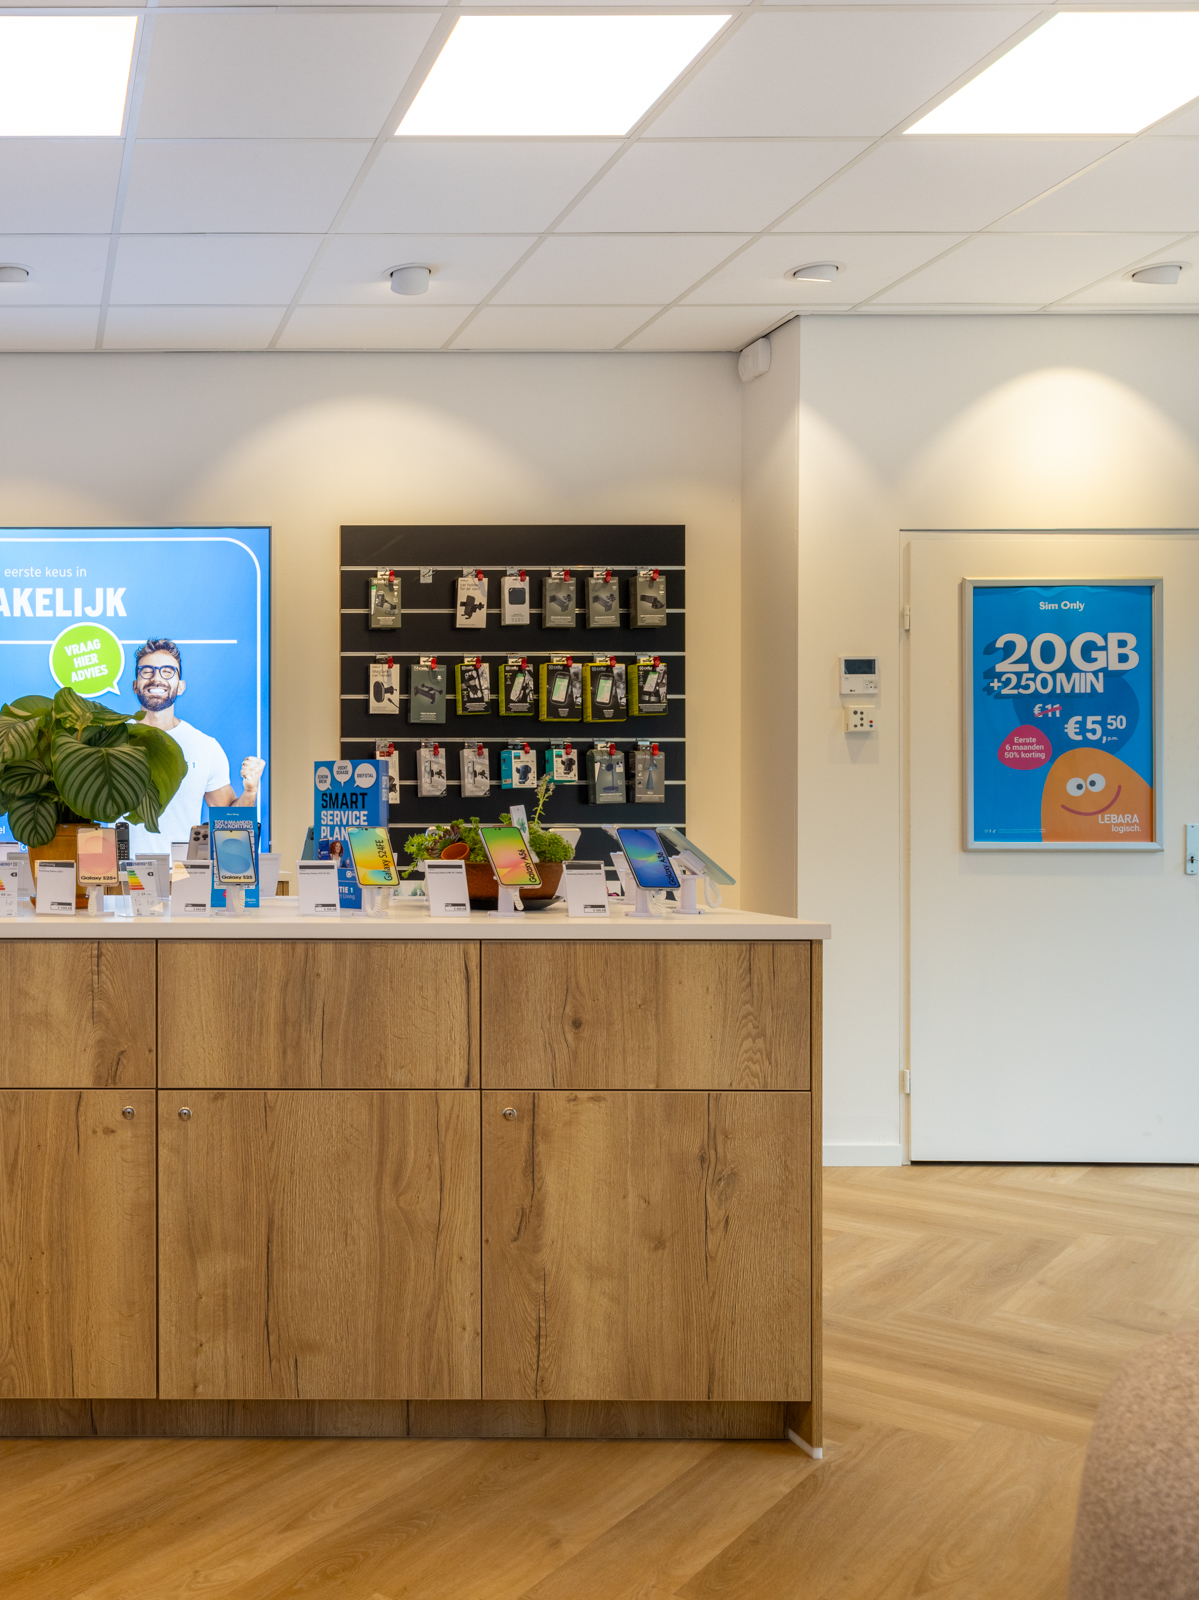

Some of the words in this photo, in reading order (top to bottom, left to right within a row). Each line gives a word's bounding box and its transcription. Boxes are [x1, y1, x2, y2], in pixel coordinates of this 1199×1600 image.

[4, 566, 41, 577] eerste
[45, 566, 73, 577] keus
[76, 566, 87, 577] in
[1039, 601, 1059, 610] Sim
[1060, 601, 1085, 612] Only
[64, 638, 101, 656] VRAAG
[73, 653, 99, 668] HIER
[71, 664, 108, 683] ADVIES
[1021, 751, 1046, 760] korting
[321, 792, 368, 809] SMART
[321, 810, 368, 825] SERVICE
[1099, 814, 1139, 824] LEBARA
[320, 826, 349, 841] PLAN
[1112, 824, 1142, 834] logisch.
[384, 859, 393, 881] Galaxy
[524, 861, 537, 883] Galaxy
[663, 864, 677, 886] Galaxy
